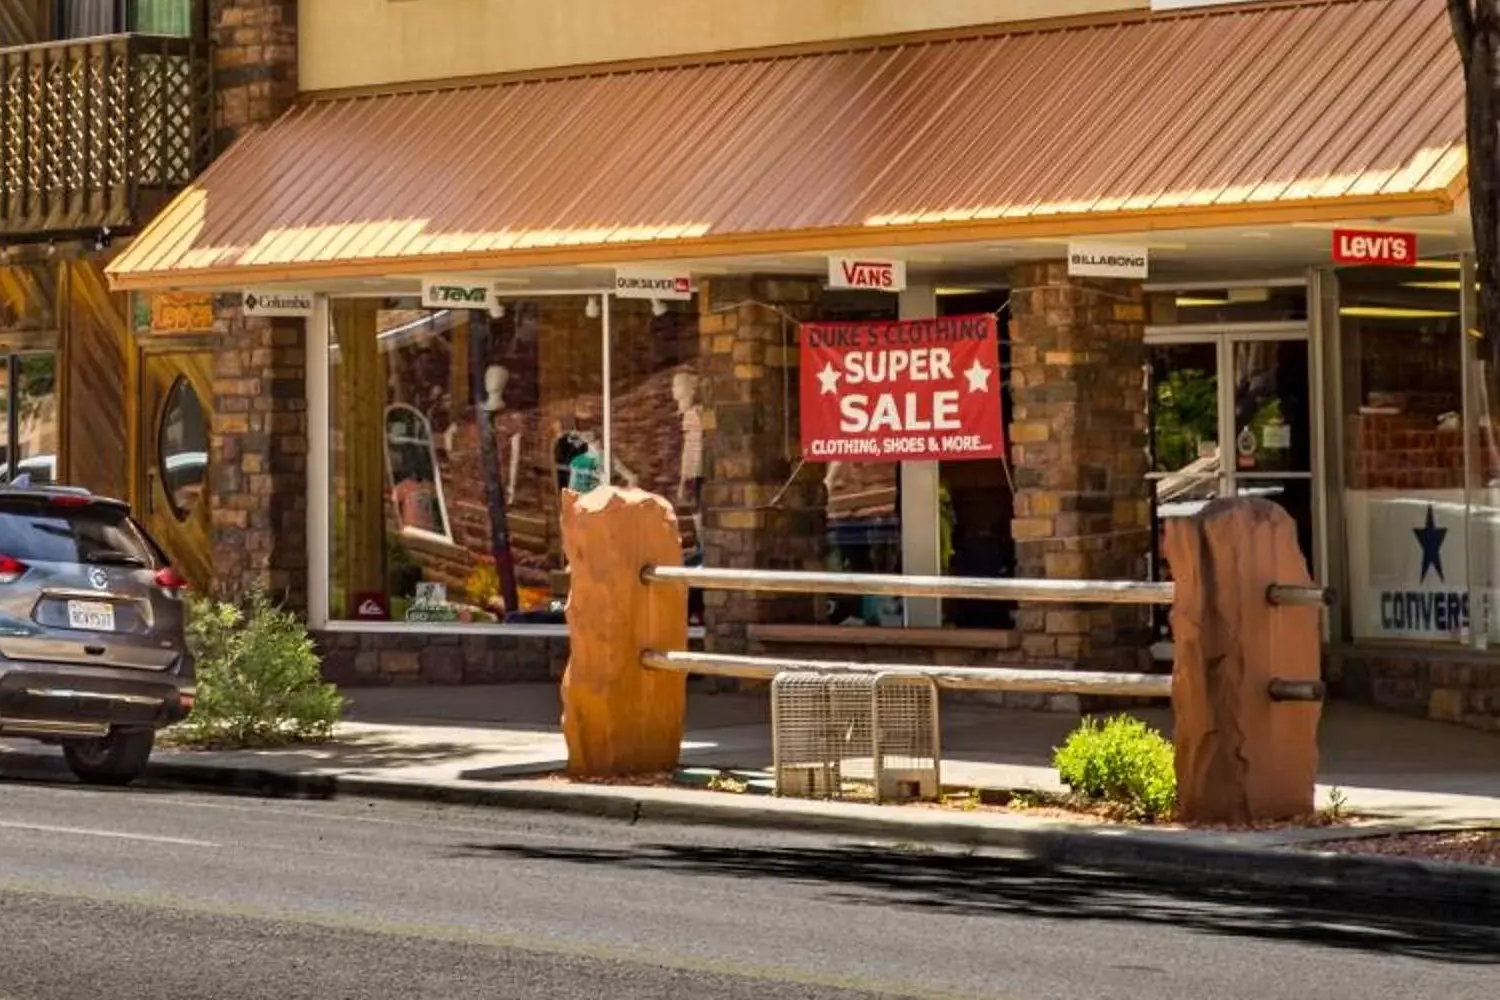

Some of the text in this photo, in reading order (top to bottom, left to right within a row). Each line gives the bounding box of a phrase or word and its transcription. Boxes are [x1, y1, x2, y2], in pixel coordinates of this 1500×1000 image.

[1071, 254, 1145, 268] BILLABONG
[617, 276, 672, 290] QUIKSILVER
[842, 260, 892, 287] VANS
[259, 295, 310, 310] Columbia
[883, 316, 988, 345] CLOTHING
[844, 347, 954, 384] SUPER
[840, 390, 962, 433] SALE
[811, 438, 881, 457] CLOTHING,
[883, 436, 925, 453] SHOES
[928, 435, 940, 452] &
